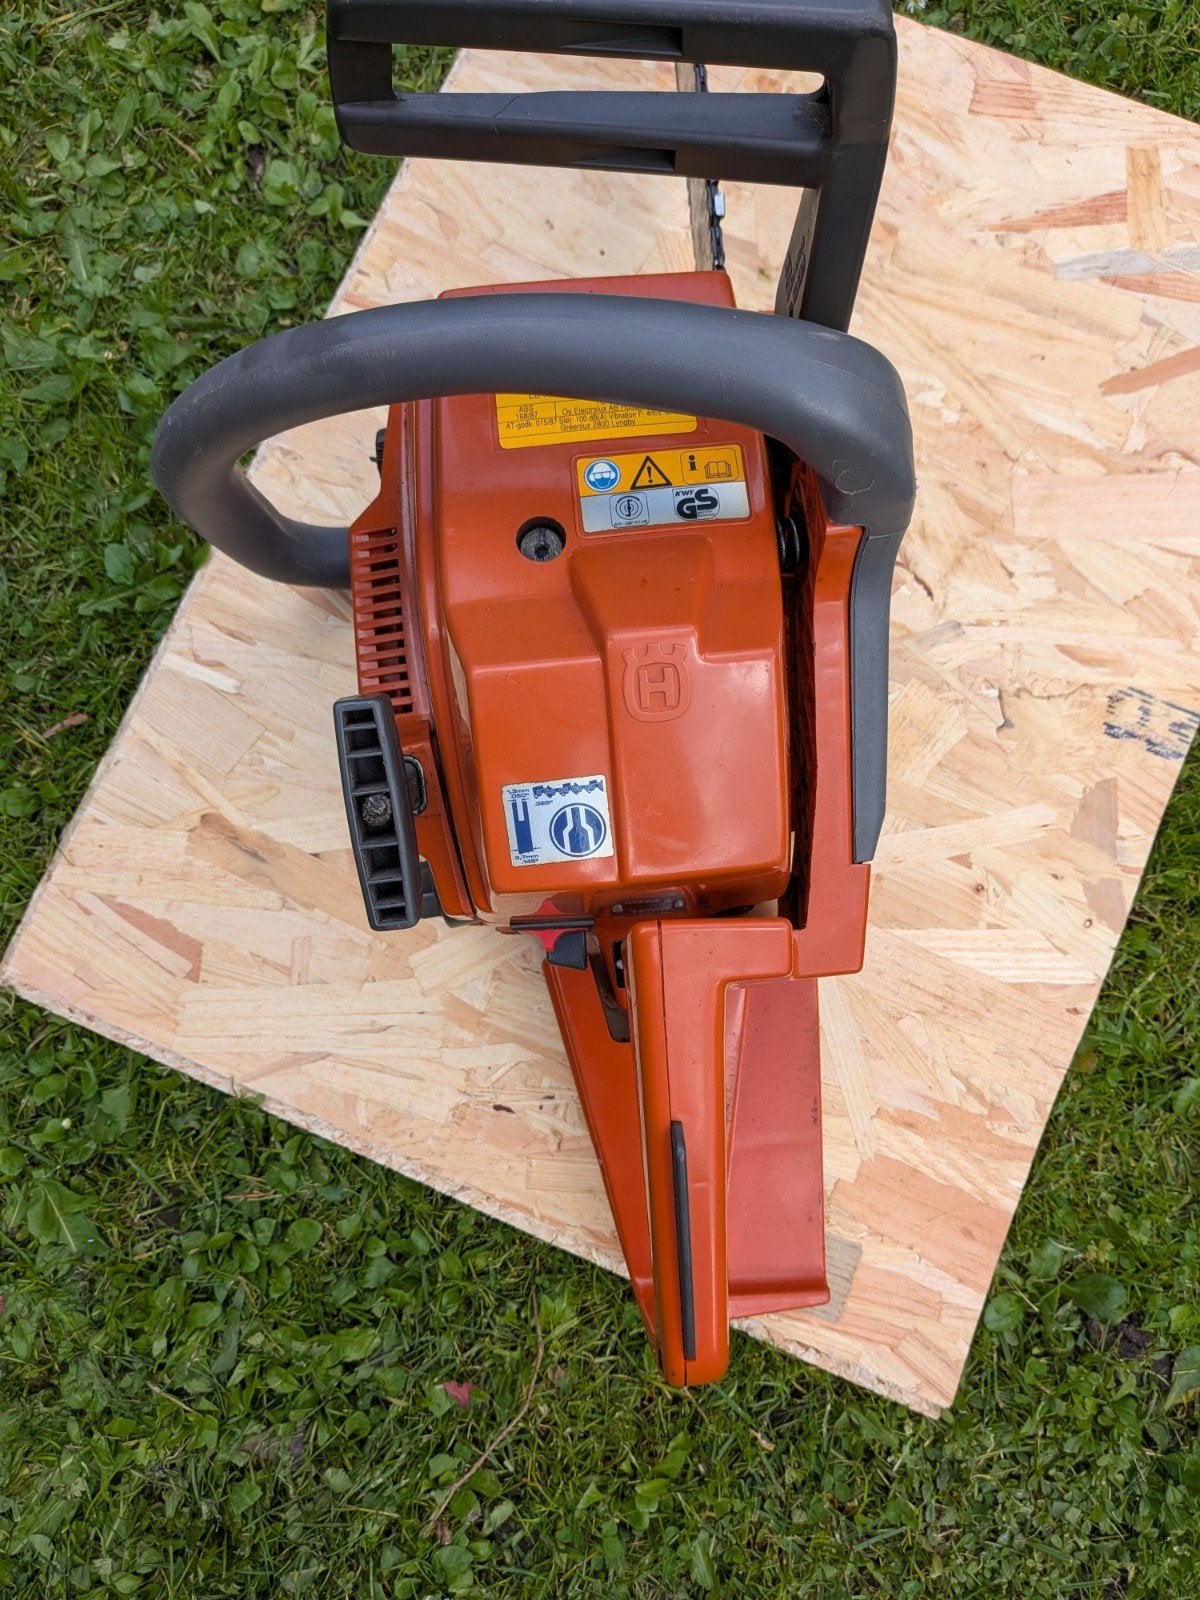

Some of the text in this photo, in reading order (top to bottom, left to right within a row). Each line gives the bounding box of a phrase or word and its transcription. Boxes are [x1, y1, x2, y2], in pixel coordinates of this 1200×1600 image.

[519, 404, 534, 412] ASS
[573, 406, 606, 415] Electrolux
[608, 411, 637, 420] Vibration
[611, 418, 636, 428] Lyngby
[675, 489, 695, 497] KWF
[676, 488, 718, 519] GS
